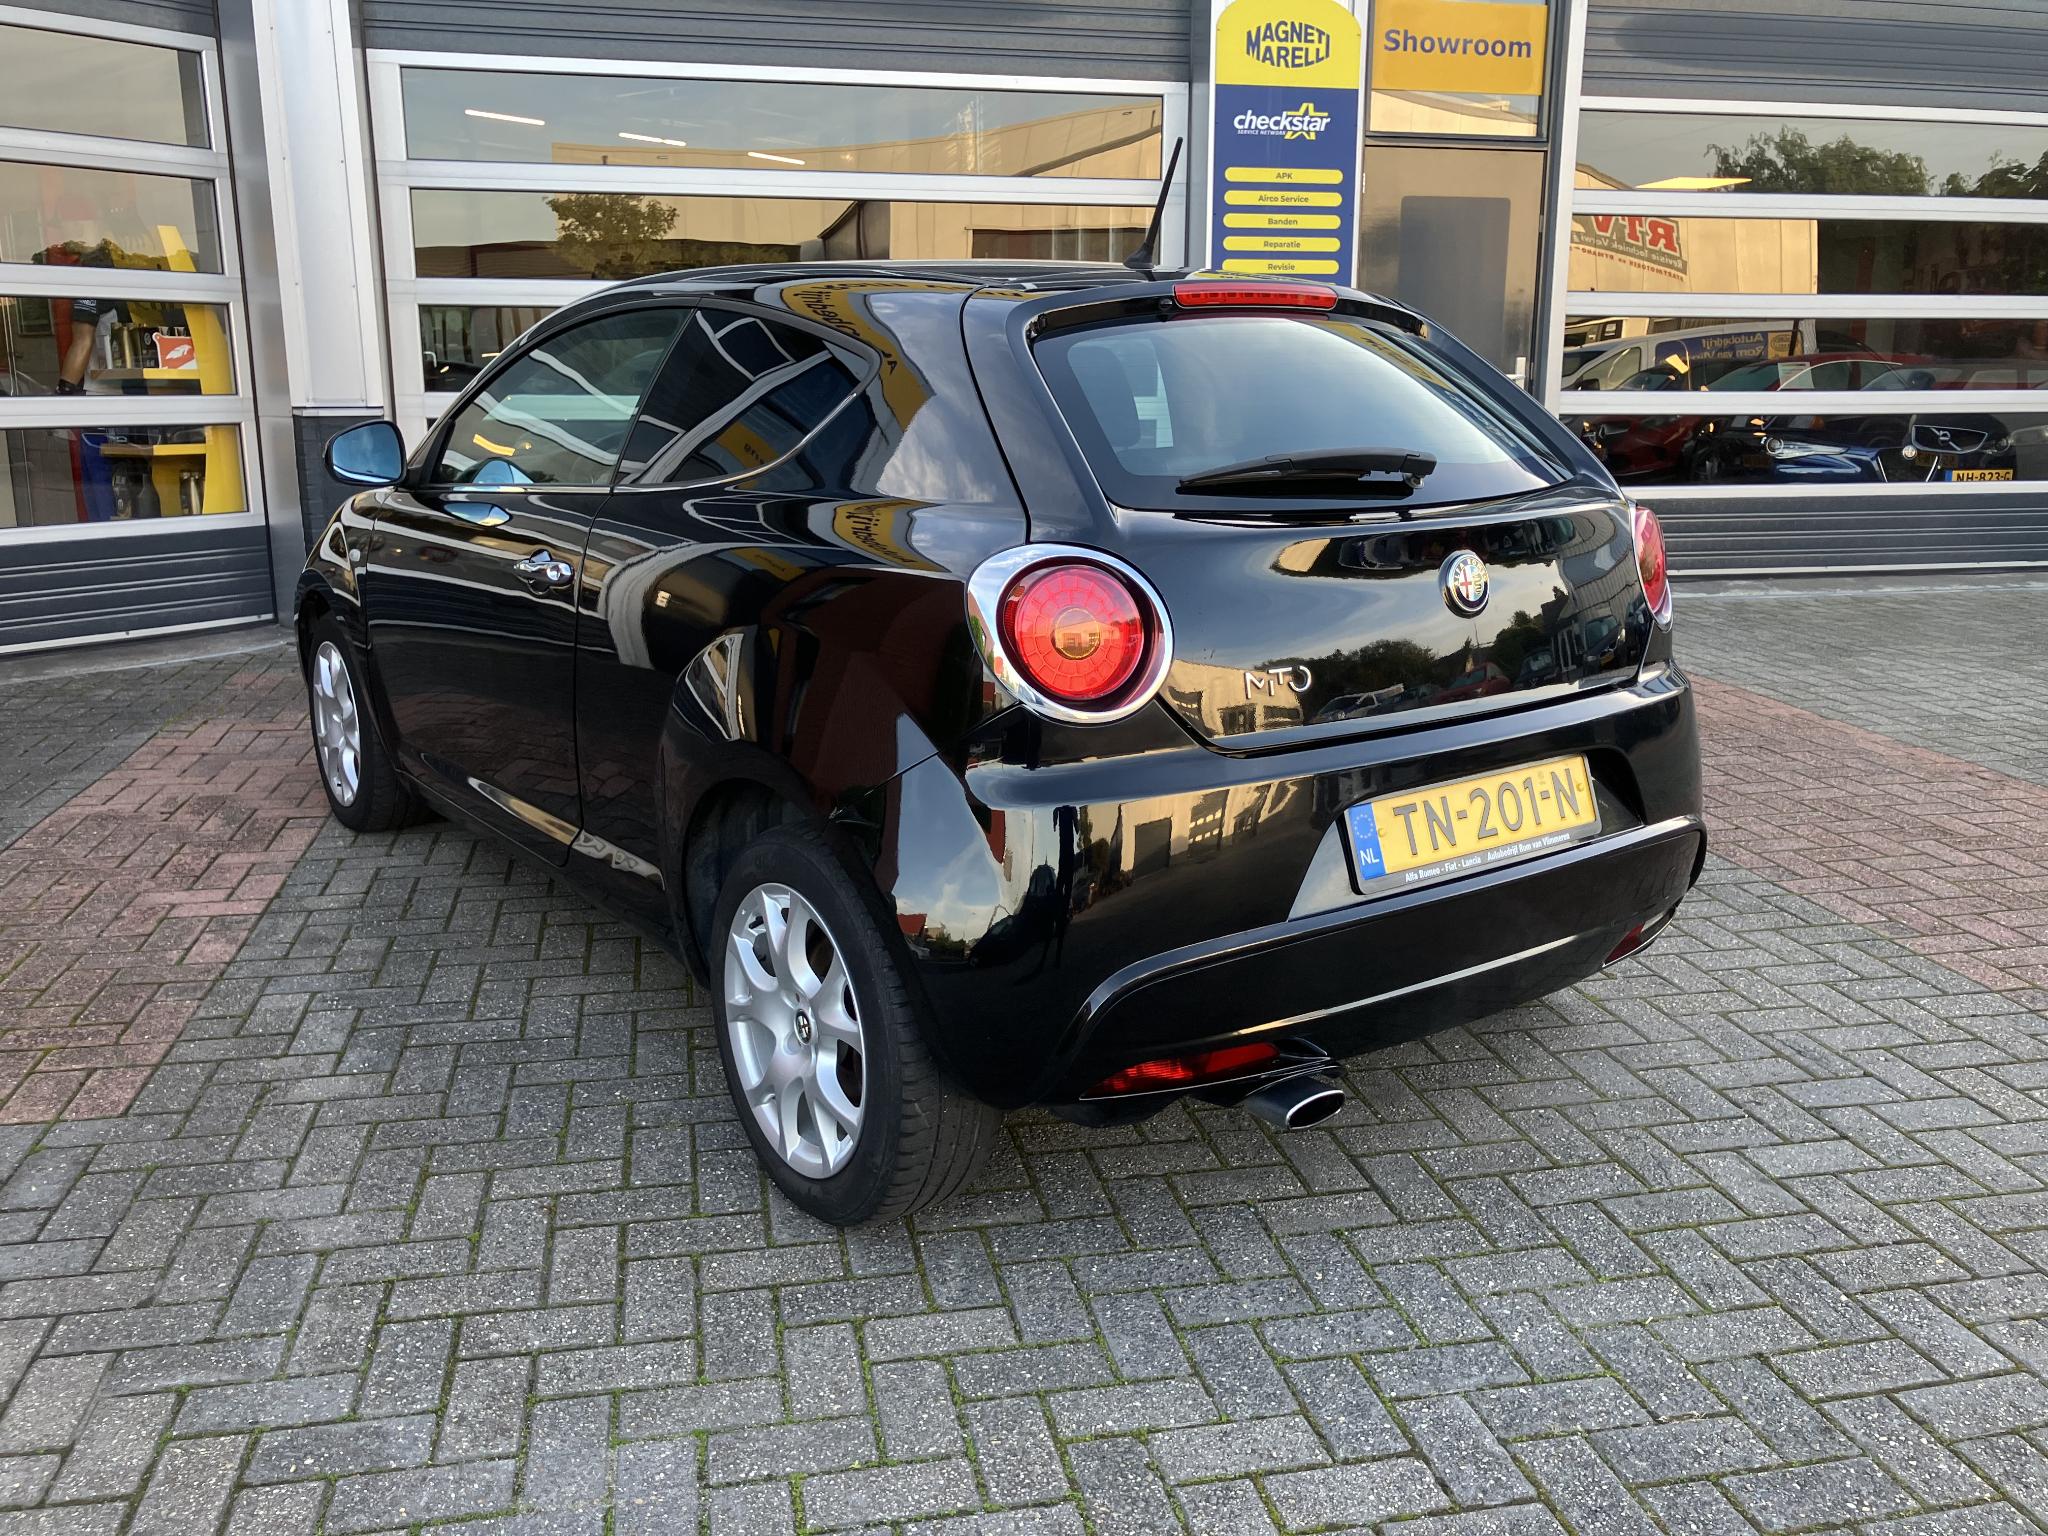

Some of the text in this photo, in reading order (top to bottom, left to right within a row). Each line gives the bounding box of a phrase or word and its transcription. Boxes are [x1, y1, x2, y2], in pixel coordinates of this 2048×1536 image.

[1246, 20, 1330, 61] MAGNETI
[1384, 29, 1531, 58] Showroom
[1233, 109, 1331, 132] checkstar
[1275, 172, 1293, 180] APK
[1258, 195, 1309, 203] Airco Service
[1267, 217, 1298, 226] Banden
[1263, 240, 1302, 249] Reparatie
[1267, 263, 1296, 271] Revisie
[1393, 768, 1580, 856] TN-201-N
[1532, 839, 1543, 850] van
[1360, 848, 1380, 867] NL
[1405, 871, 1419, 883] Alfa
[1419, 867, 1441, 879] Romeo
[1445, 862, 1457, 873] Fiat
[1462, 855, 1482, 868] Lancia
